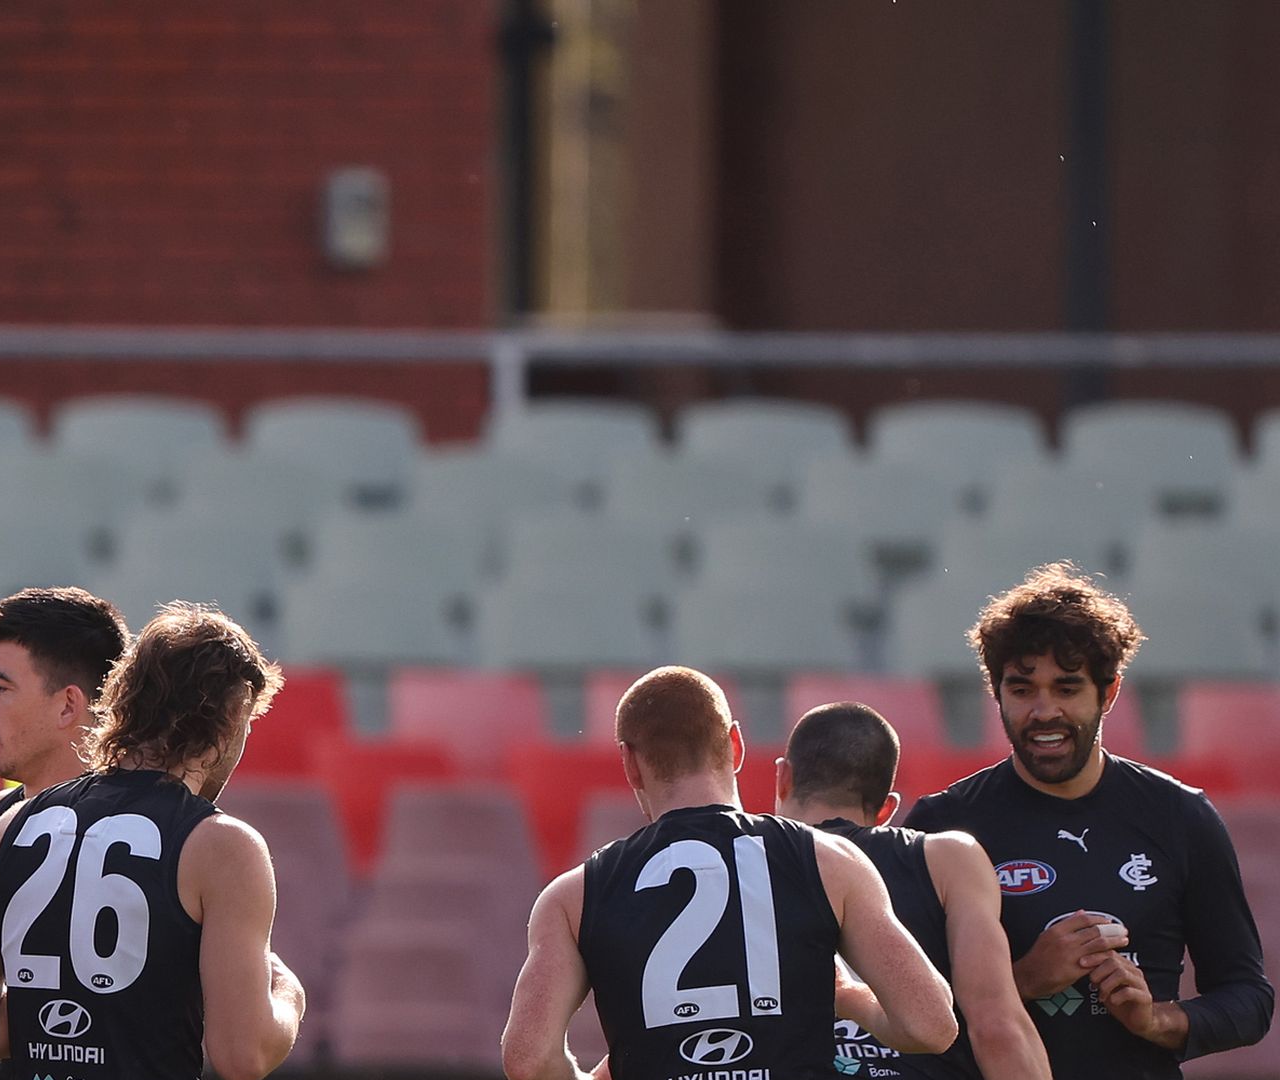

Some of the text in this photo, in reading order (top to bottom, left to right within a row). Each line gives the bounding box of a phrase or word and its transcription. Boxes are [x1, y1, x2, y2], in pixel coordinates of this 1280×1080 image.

[998, 867, 1050, 887] AFL
[0, 805, 162, 995] 26
[634, 834, 783, 1030] 21
[92, 976, 113, 986] AFL
[675, 1005, 699, 1016] AFL
[755, 999, 778, 1008] AFL
[28, 1042, 105, 1064] HYUNDAI
